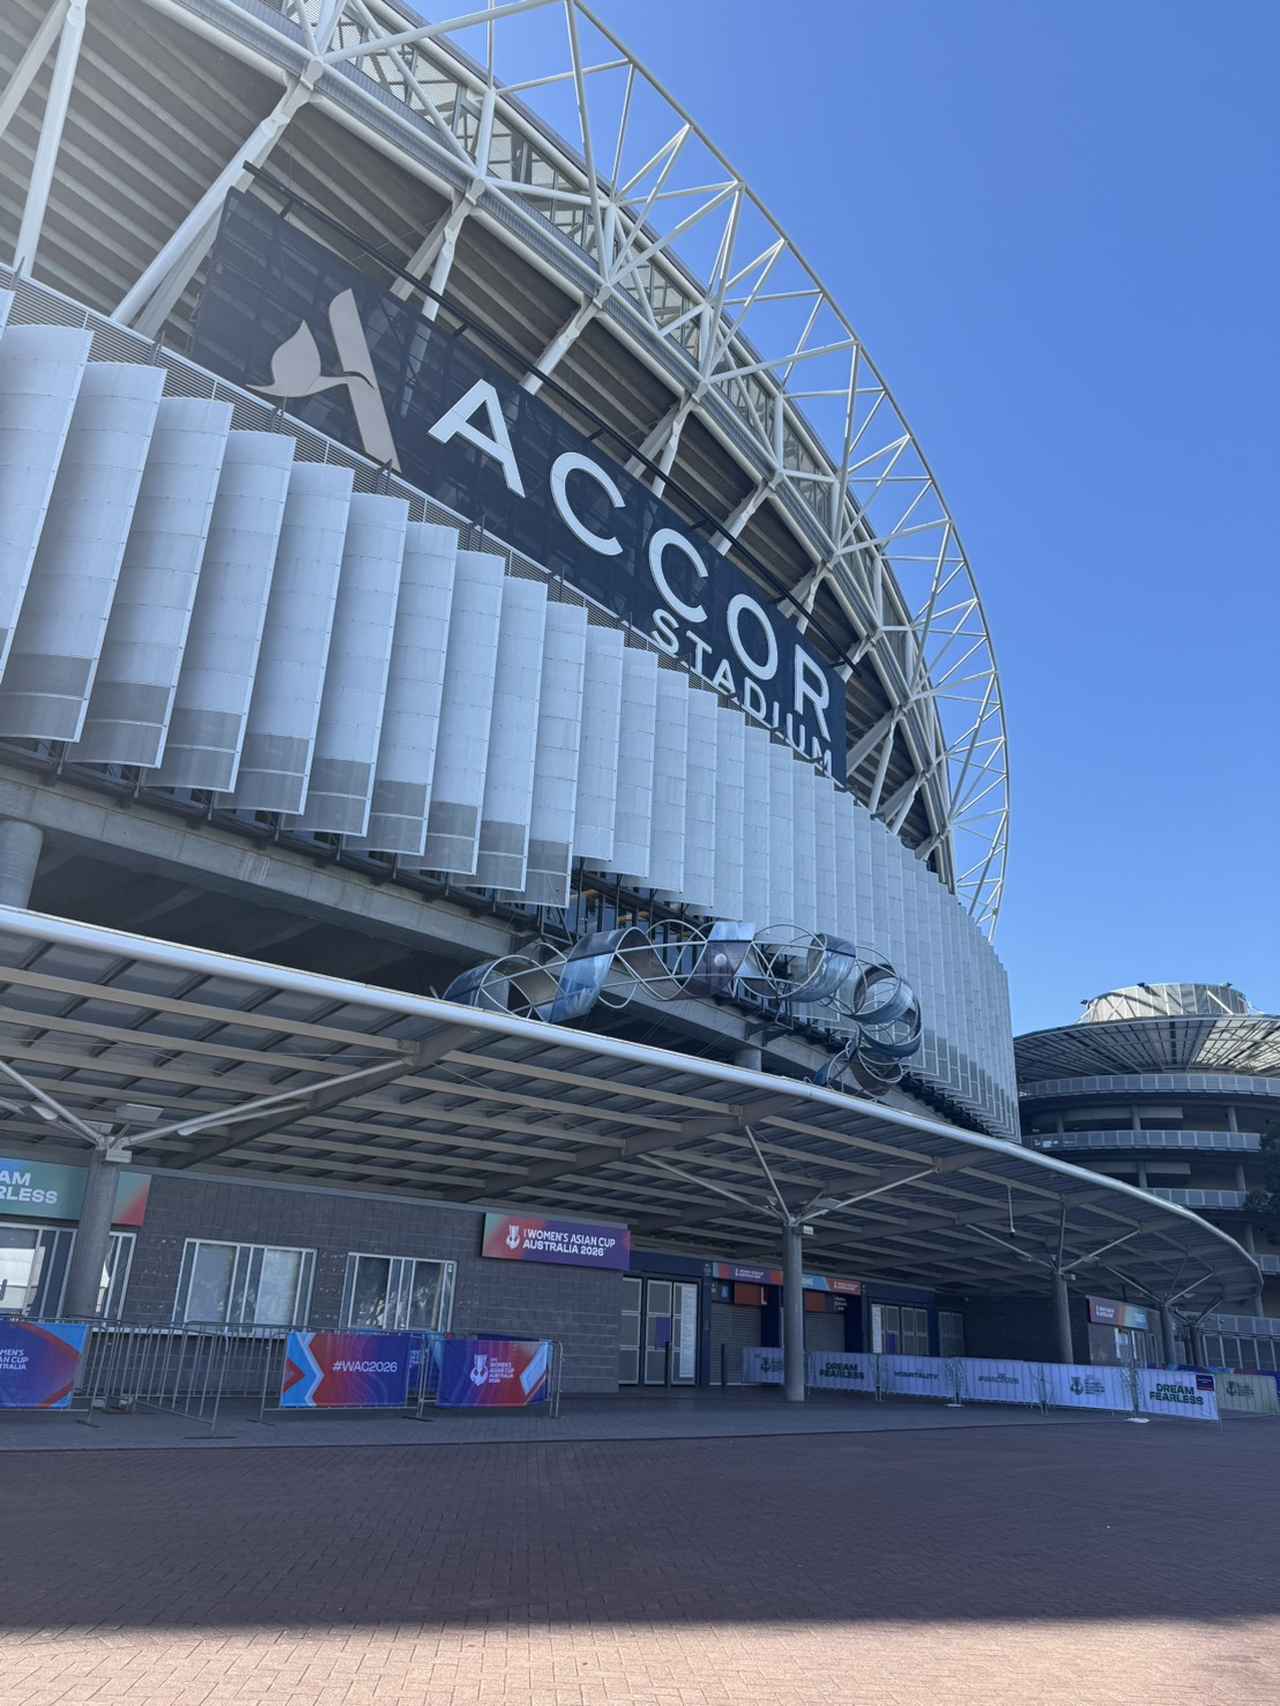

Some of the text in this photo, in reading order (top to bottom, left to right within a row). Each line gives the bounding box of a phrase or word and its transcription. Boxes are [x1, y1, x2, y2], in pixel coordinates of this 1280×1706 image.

[428, 379, 832, 743] ACCOR
[650, 608, 832, 777] STADIUM
[527, 1229, 569, 1242] WOMEN'S
[570, 1233, 597, 1246] ASIAN
[598, 1237, 616, 1248] CUP
[522, 1239, 605, 1256] AUSTRALIA 2026
[332, 1360, 398, 1372] #WAC2026
[1156, 1383, 1195, 1394] DREAM
[1149, 1391, 1204, 1405] FEARLESS
